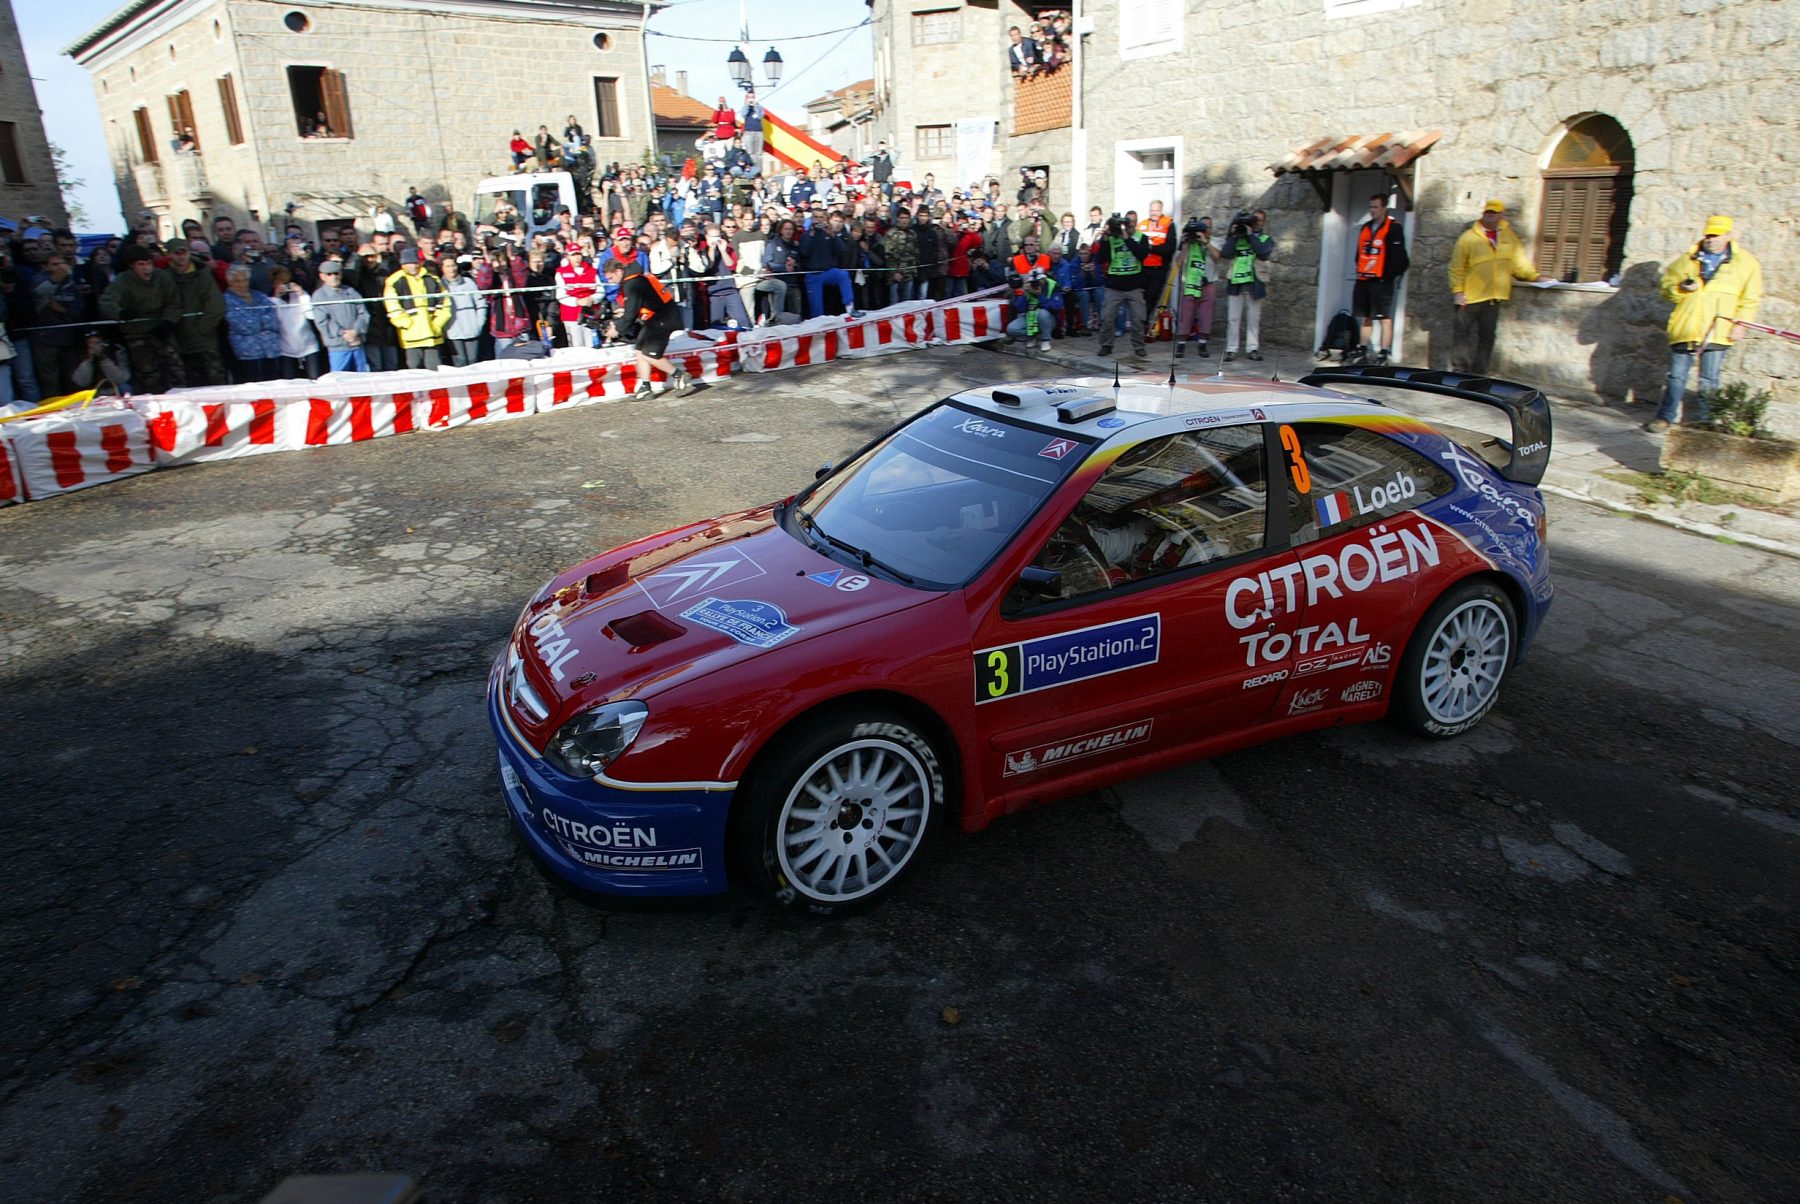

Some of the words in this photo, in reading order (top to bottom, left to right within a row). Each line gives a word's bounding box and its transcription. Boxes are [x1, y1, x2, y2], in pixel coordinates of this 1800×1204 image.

[953, 417, 1006, 438] Xsara
[1280, 424, 1311, 494] 3
[1518, 441, 1547, 456] TOTAL
[1353, 471, 1415, 515] Loeb
[1441, 442, 1534, 527] Xsara
[839, 577, 866, 589] E
[1225, 523, 1440, 629] CITROËN
[700, 608, 727, 621] RALLYE
[726, 617, 739, 626] DE
[529, 599, 579, 681] TOTAL
[1239, 617, 1370, 667] TOTAL
[1333, 651, 1362, 661] RACING
[988, 651, 1009, 697] 3
[1242, 669, 1289, 689] RECARO
[852, 722, 943, 804] MICHELIN
[1041, 725, 1149, 762] MICHELIN
[543, 808, 656, 847] CITROËN
[584, 851, 698, 867] MICHELIN
